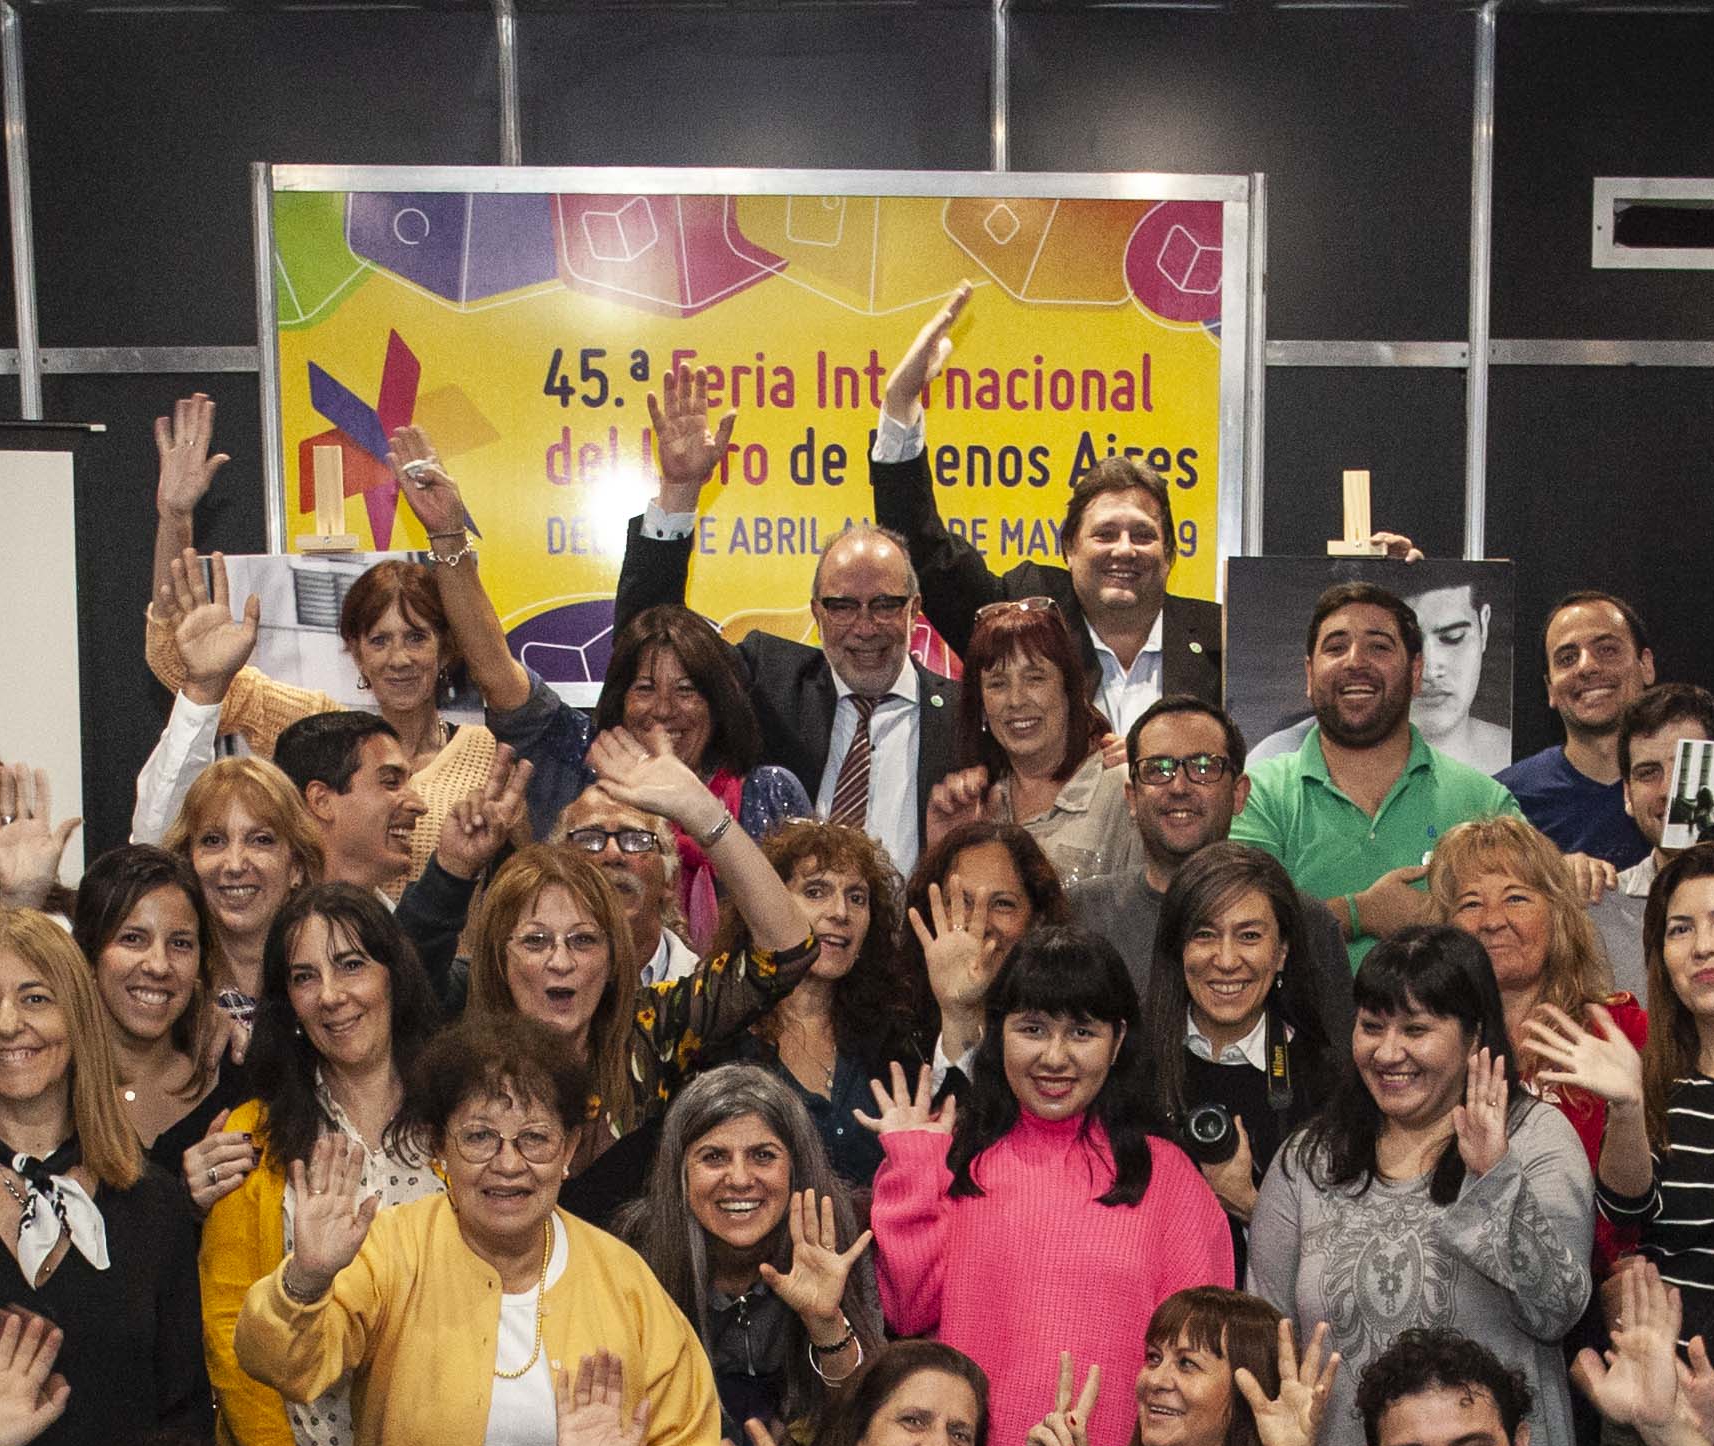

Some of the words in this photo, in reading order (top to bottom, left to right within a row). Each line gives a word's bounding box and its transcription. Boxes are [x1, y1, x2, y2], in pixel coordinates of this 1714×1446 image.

[817, 350, 1154, 412] Intrnacional
[790, 427, 848, 486] de
[728, 517, 824, 556] ABRIL
[1001, 519, 1064, 557] MAY
